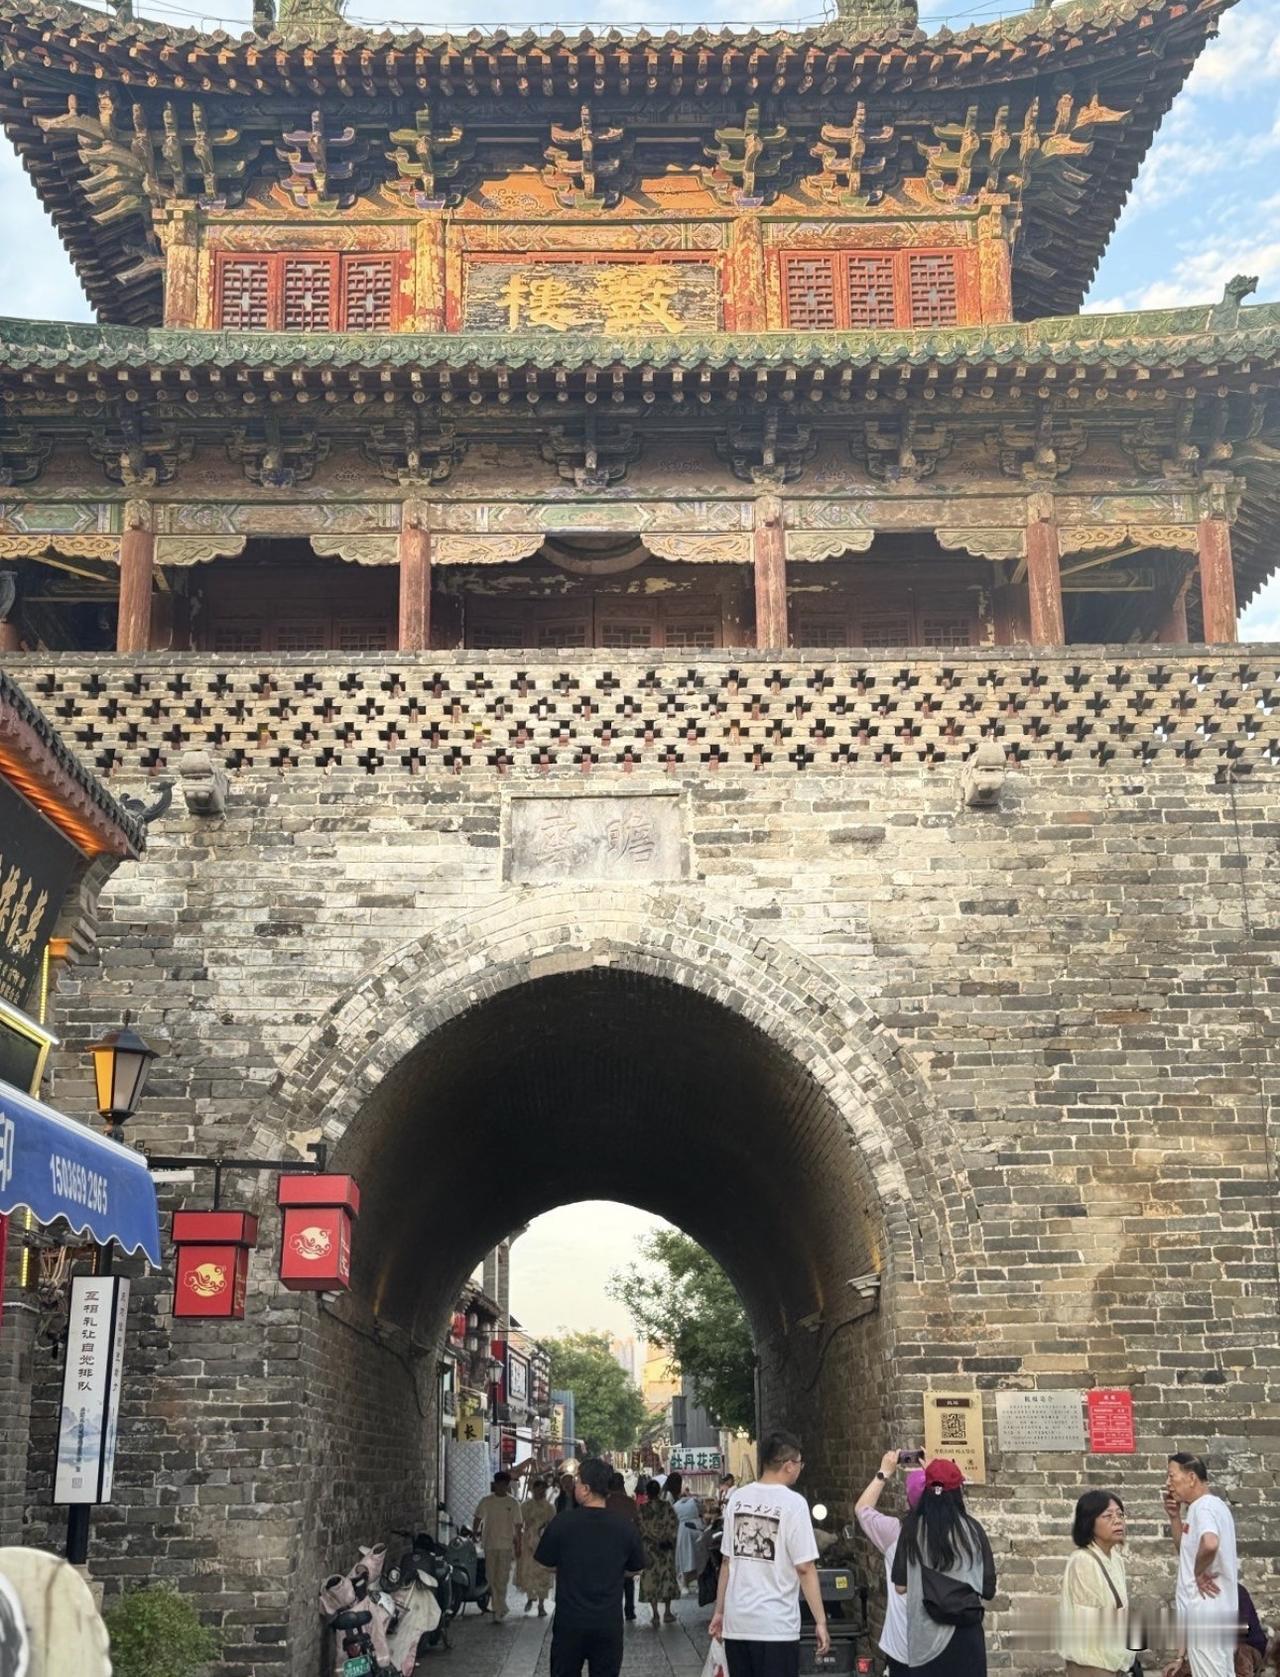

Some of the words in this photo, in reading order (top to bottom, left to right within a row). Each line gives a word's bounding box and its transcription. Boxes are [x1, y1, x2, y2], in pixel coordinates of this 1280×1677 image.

[77, 1291, 99, 1391] 互相礼让自觉排队
[670, 1452, 721, 1470] 牡丹花酒
